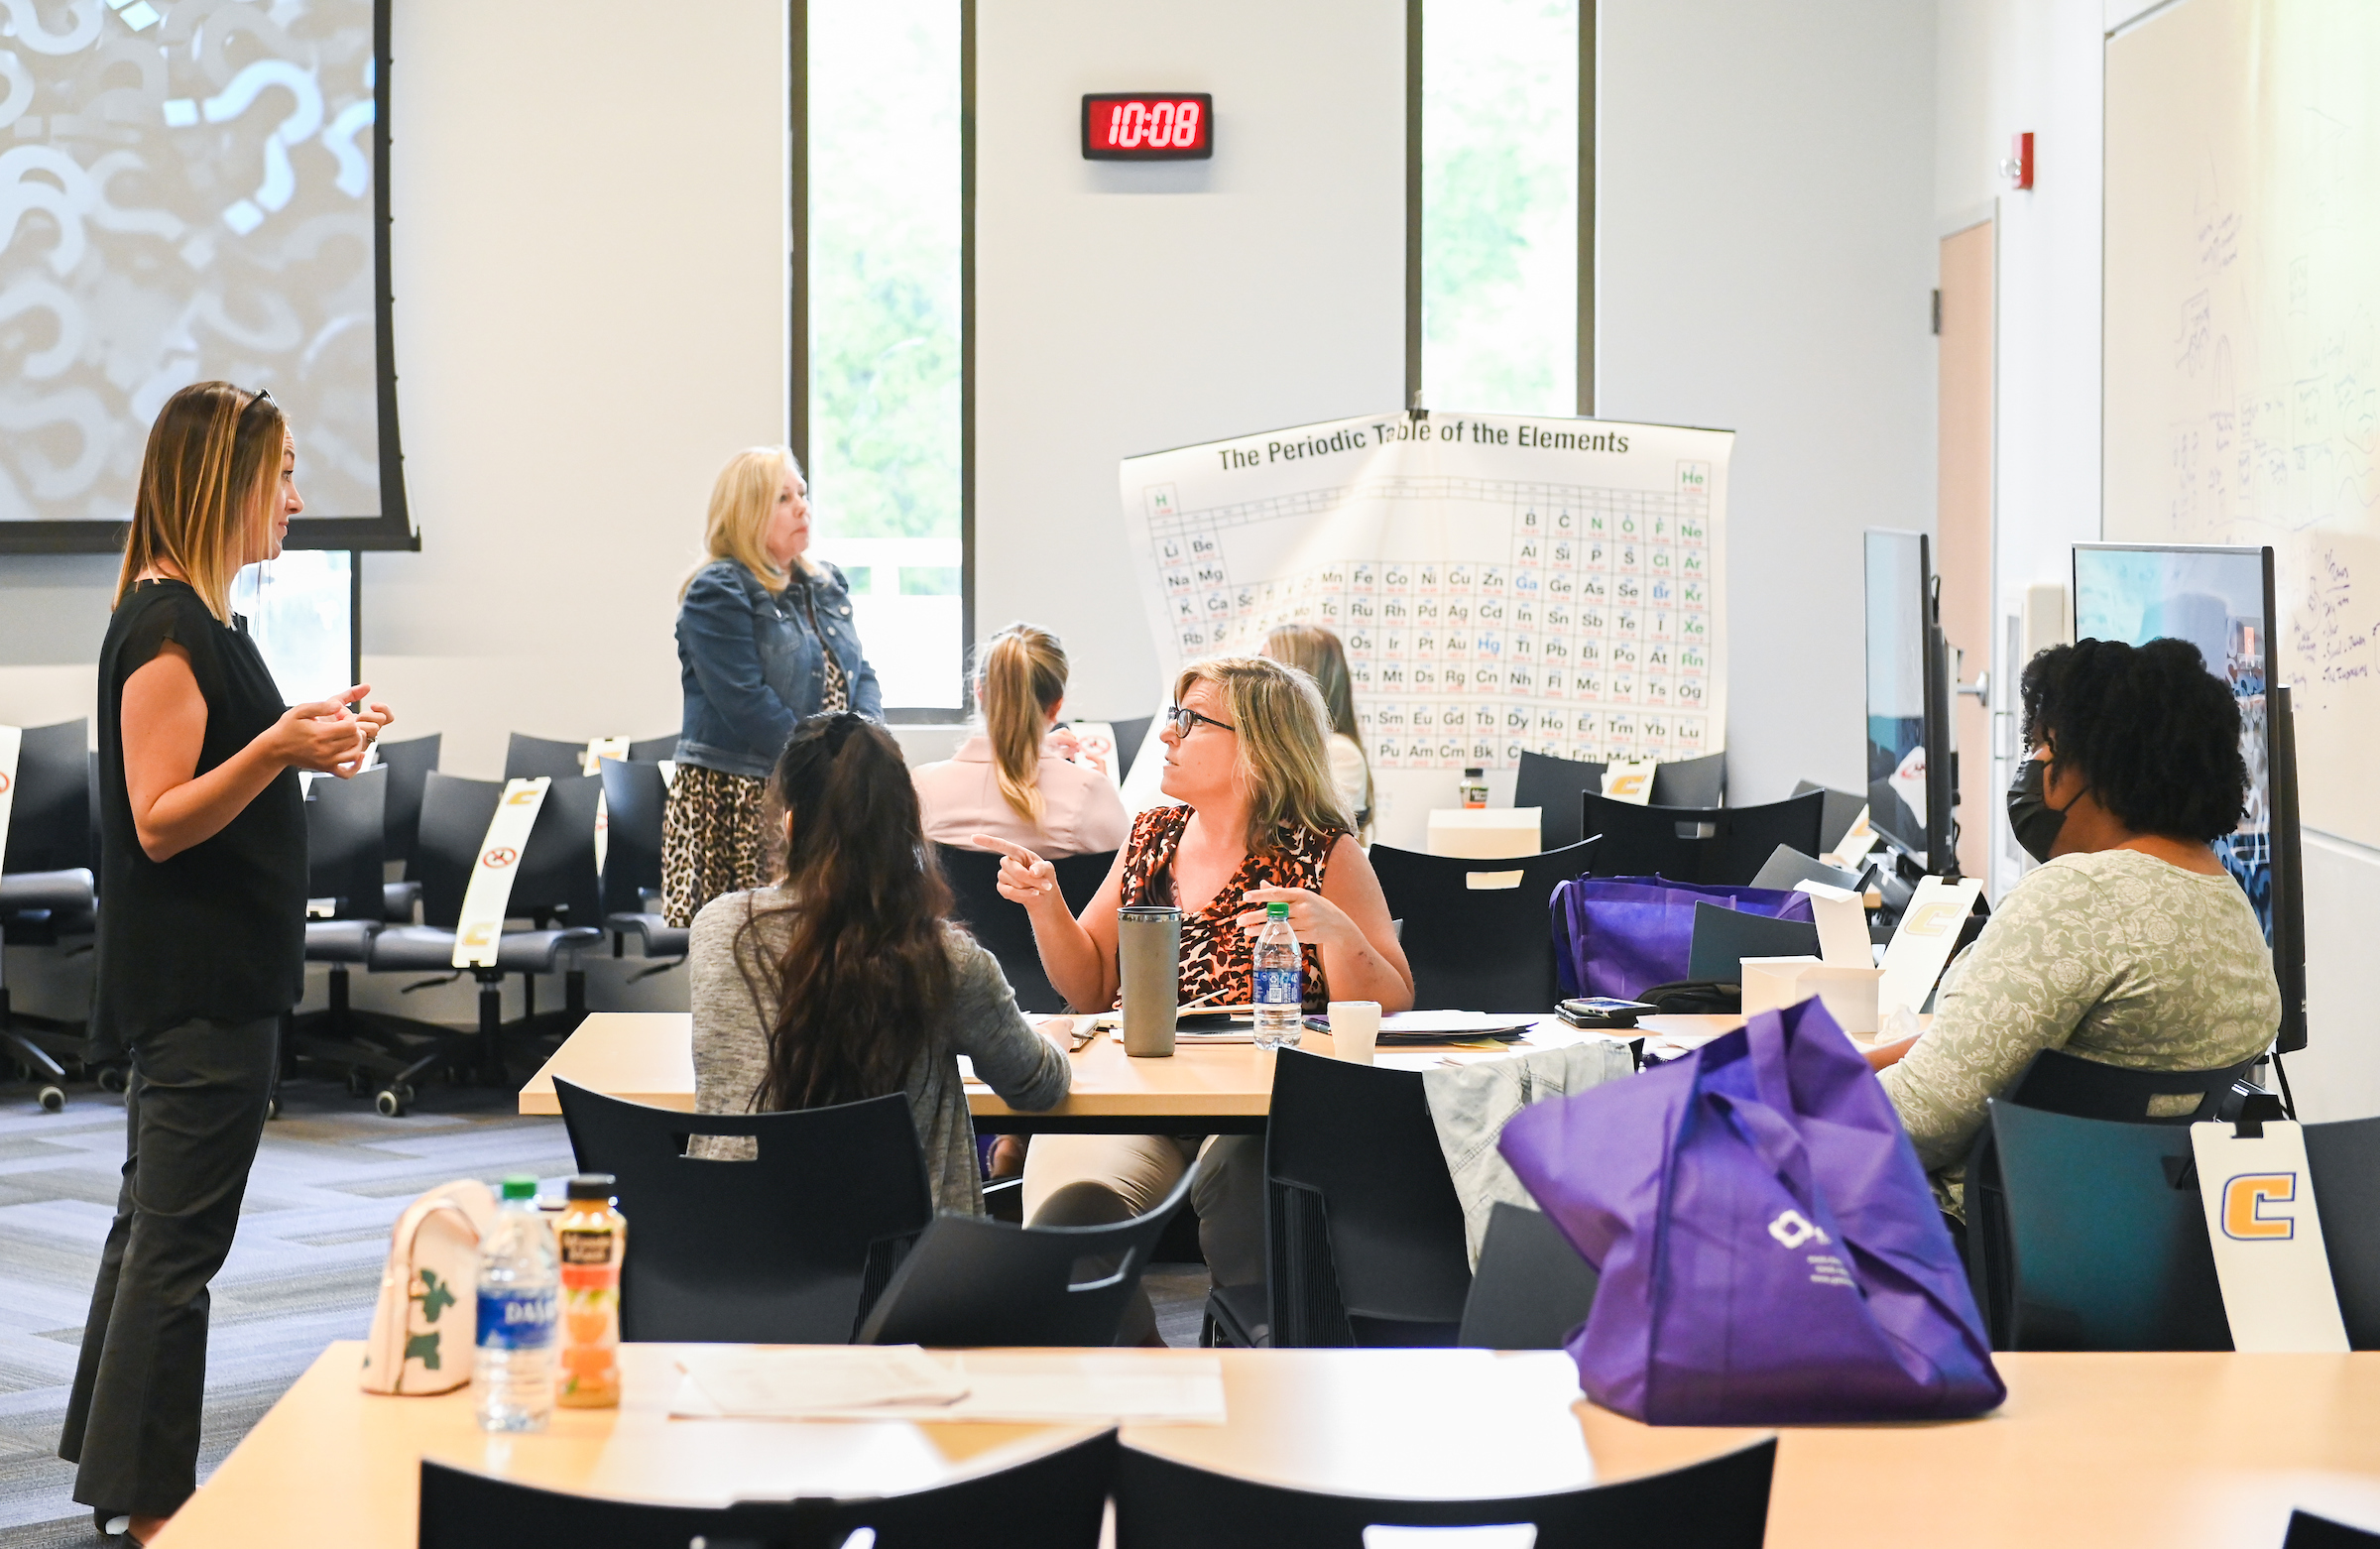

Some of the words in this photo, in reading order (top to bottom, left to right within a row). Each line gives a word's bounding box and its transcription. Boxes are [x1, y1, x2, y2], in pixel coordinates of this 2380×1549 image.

[1108, 101, 1200, 148] 10:08
[1219, 448, 1260, 470] The
[1268, 429, 1367, 463] Periodic
[1371, 420, 1431, 444] Table
[1441, 421, 1466, 443] of
[1473, 423, 1508, 445] the
[1518, 425, 1629, 453] Elements
[1682, 470, 1704, 484] He
[1155, 495, 1167, 507] H
[1525, 513, 1536, 526] B
[1559, 514, 1570, 528] C
[1592, 517, 1603, 529] N
[1622, 520, 1634, 533] O
[1655, 522, 1664, 534] F
[1682, 525, 1703, 538] Ne
[1193, 540, 1214, 553] Be
[1521, 545, 1536, 558] Al
[1556, 547, 1570, 560] Si
[1592, 549, 1602, 562] P
[1624, 551, 1635, 564] S
[1653, 553, 1669, 567] Cl
[1684, 556, 1701, 570] Ar
[1168, 576, 1190, 588] Na
[1198, 569, 1224, 583] Mg
[1181, 603, 1193, 615] K
[1208, 597, 1229, 611] Ca
[1355, 571, 1373, 583] Fe
[1385, 572, 1408, 585] Co
[1421, 571, 1437, 584] Ni
[1449, 572, 1471, 585] Cu
[1483, 573, 1503, 587] Zn
[1515, 577, 1537, 590] Ga
[1549, 579, 1572, 593] Ge
[1584, 582, 1605, 596] As
[1618, 584, 1638, 597] Se
[1653, 586, 1670, 599] Br
[1685, 588, 1703, 601] Kr
[1321, 603, 1338, 616] Tc
[1352, 604, 1373, 617] Ru
[1385, 605, 1406, 618] Rh
[1418, 605, 1437, 618] Pd
[1448, 606, 1469, 621] Ag
[1480, 606, 1502, 619] Cd
[1517, 609, 1532, 621] In
[1548, 611, 1569, 625] Sn
[1582, 614, 1604, 628] Sb
[1617, 616, 1635, 630] Te
[1684, 621, 1704, 634] Xe
[1350, 636, 1372, 650] Os
[1389, 637, 1399, 650] Ir
[1419, 637, 1434, 650] Pt
[1447, 638, 1467, 651] Au
[1479, 638, 1500, 655] Hg
[1516, 641, 1530, 653] Tl
[1546, 644, 1567, 656] Pb
[1583, 646, 1599, 658] Bi
[1614, 649, 1635, 662] Po
[1650, 652, 1667, 663] At
[1681, 654, 1704, 666] Rn
[1382, 670, 1403, 683] Mt
[1415, 670, 1435, 683] Ds
[1446, 670, 1466, 686] Rg
[1476, 670, 1498, 683] Cn
[1510, 672, 1531, 686] Nh
[1548, 675, 1561, 688] Fl
[1577, 678, 1601, 691] Mc
[1614, 680, 1631, 694] Lv
[1649, 682, 1667, 695] Ts
[1679, 684, 1702, 700] Og
[1378, 712, 1404, 725] Sm
[1413, 712, 1433, 725] Eu
[1443, 712, 1465, 726] Gd
[1476, 713, 1494, 726] Tb
[1507, 714, 1529, 729] Dy
[1541, 716, 1564, 730] Ho
[1579, 719, 1596, 732] Er
[1608, 720, 1633, 735] Tm
[1645, 723, 1666, 736] Yb
[1679, 725, 1700, 738] Lu
[1380, 745, 1400, 759] Pu
[1409, 746, 1434, 758] Am
[1440, 745, 1466, 759] Cm
[1474, 746, 1494, 759] Bk
[506, 789, 540, 805] C
[1608, 774, 1647, 795] C
[1903, 901, 1965, 937] C
[2220, 1172, 2297, 1242] C
